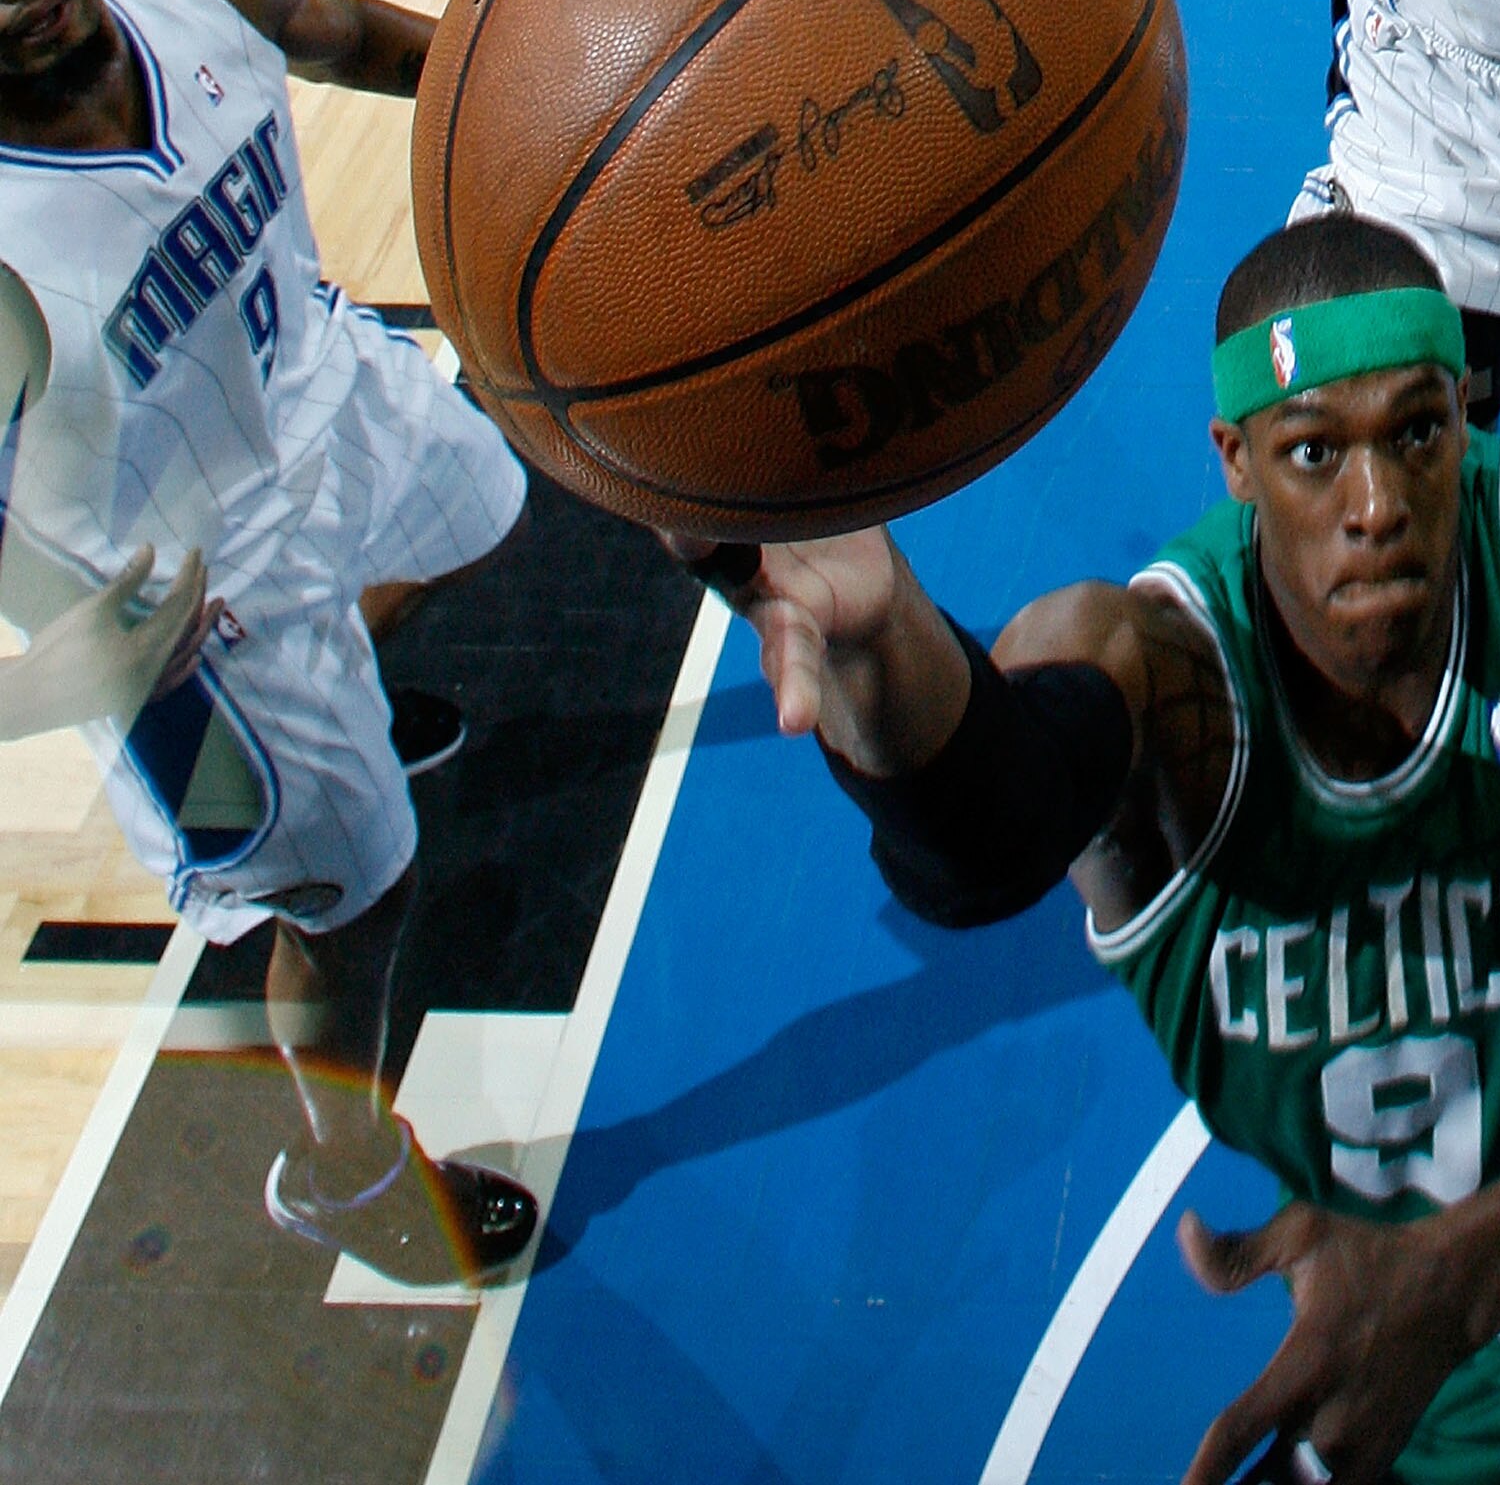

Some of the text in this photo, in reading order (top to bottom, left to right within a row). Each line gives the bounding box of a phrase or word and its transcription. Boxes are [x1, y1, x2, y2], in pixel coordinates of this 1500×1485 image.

[101, 109, 288, 391] MAGIC
[798, 94, 1182, 470] PALDING
[1320, 1033, 1483, 1206] 9
